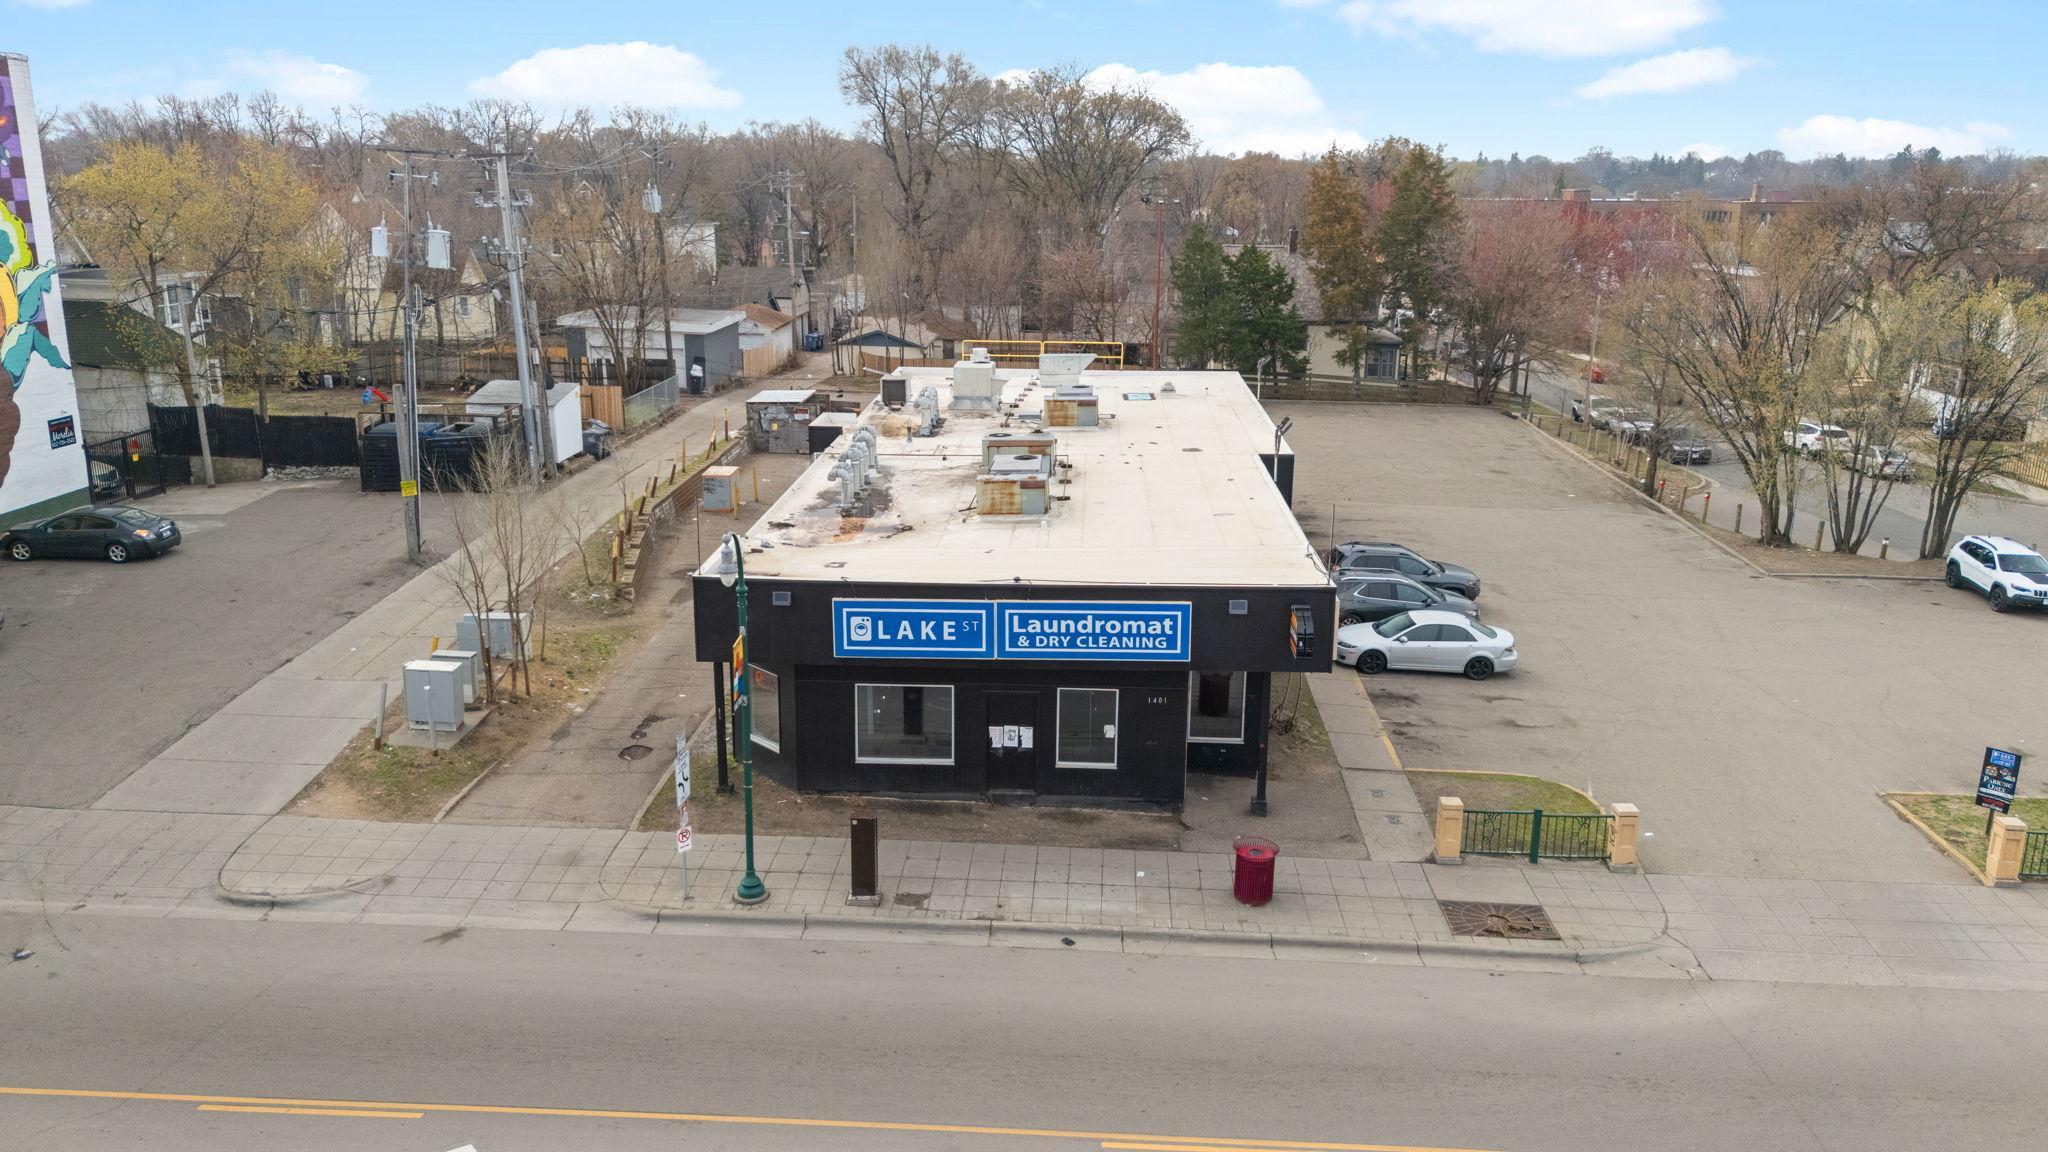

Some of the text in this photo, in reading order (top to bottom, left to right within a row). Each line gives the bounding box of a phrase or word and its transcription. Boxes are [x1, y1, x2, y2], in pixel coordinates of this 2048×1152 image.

[878, 620, 979, 640] LAKE ST
[1013, 615, 1173, 634] Laundromat
[1018, 636, 1167, 648] & DRY CLEANING
[1987, 783, 2007, 793] ONLY
